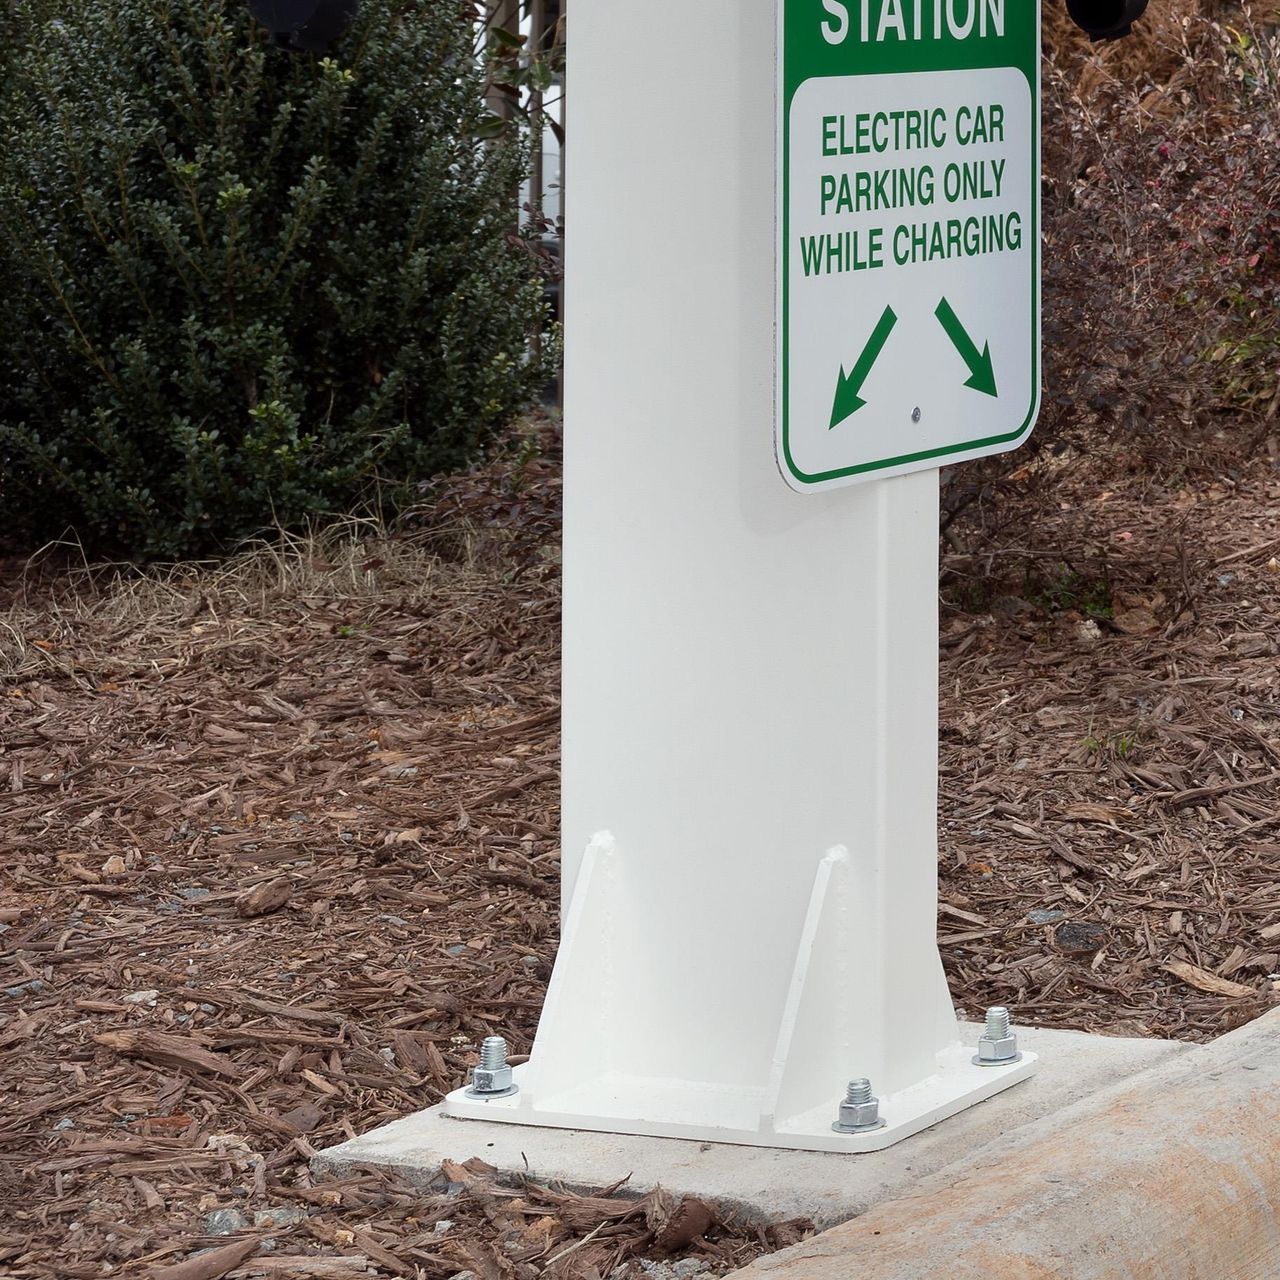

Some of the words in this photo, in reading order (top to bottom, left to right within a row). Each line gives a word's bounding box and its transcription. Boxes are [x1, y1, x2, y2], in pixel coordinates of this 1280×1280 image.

[822, 107, 947, 157] ELECTRIC
[955, 104, 1005, 146] CAR
[820, 165, 935, 216] PARKING
[943, 159, 1006, 203] ONLY
[799, 228, 884, 277] WHILE
[892, 211, 1022, 266] CHARGING
